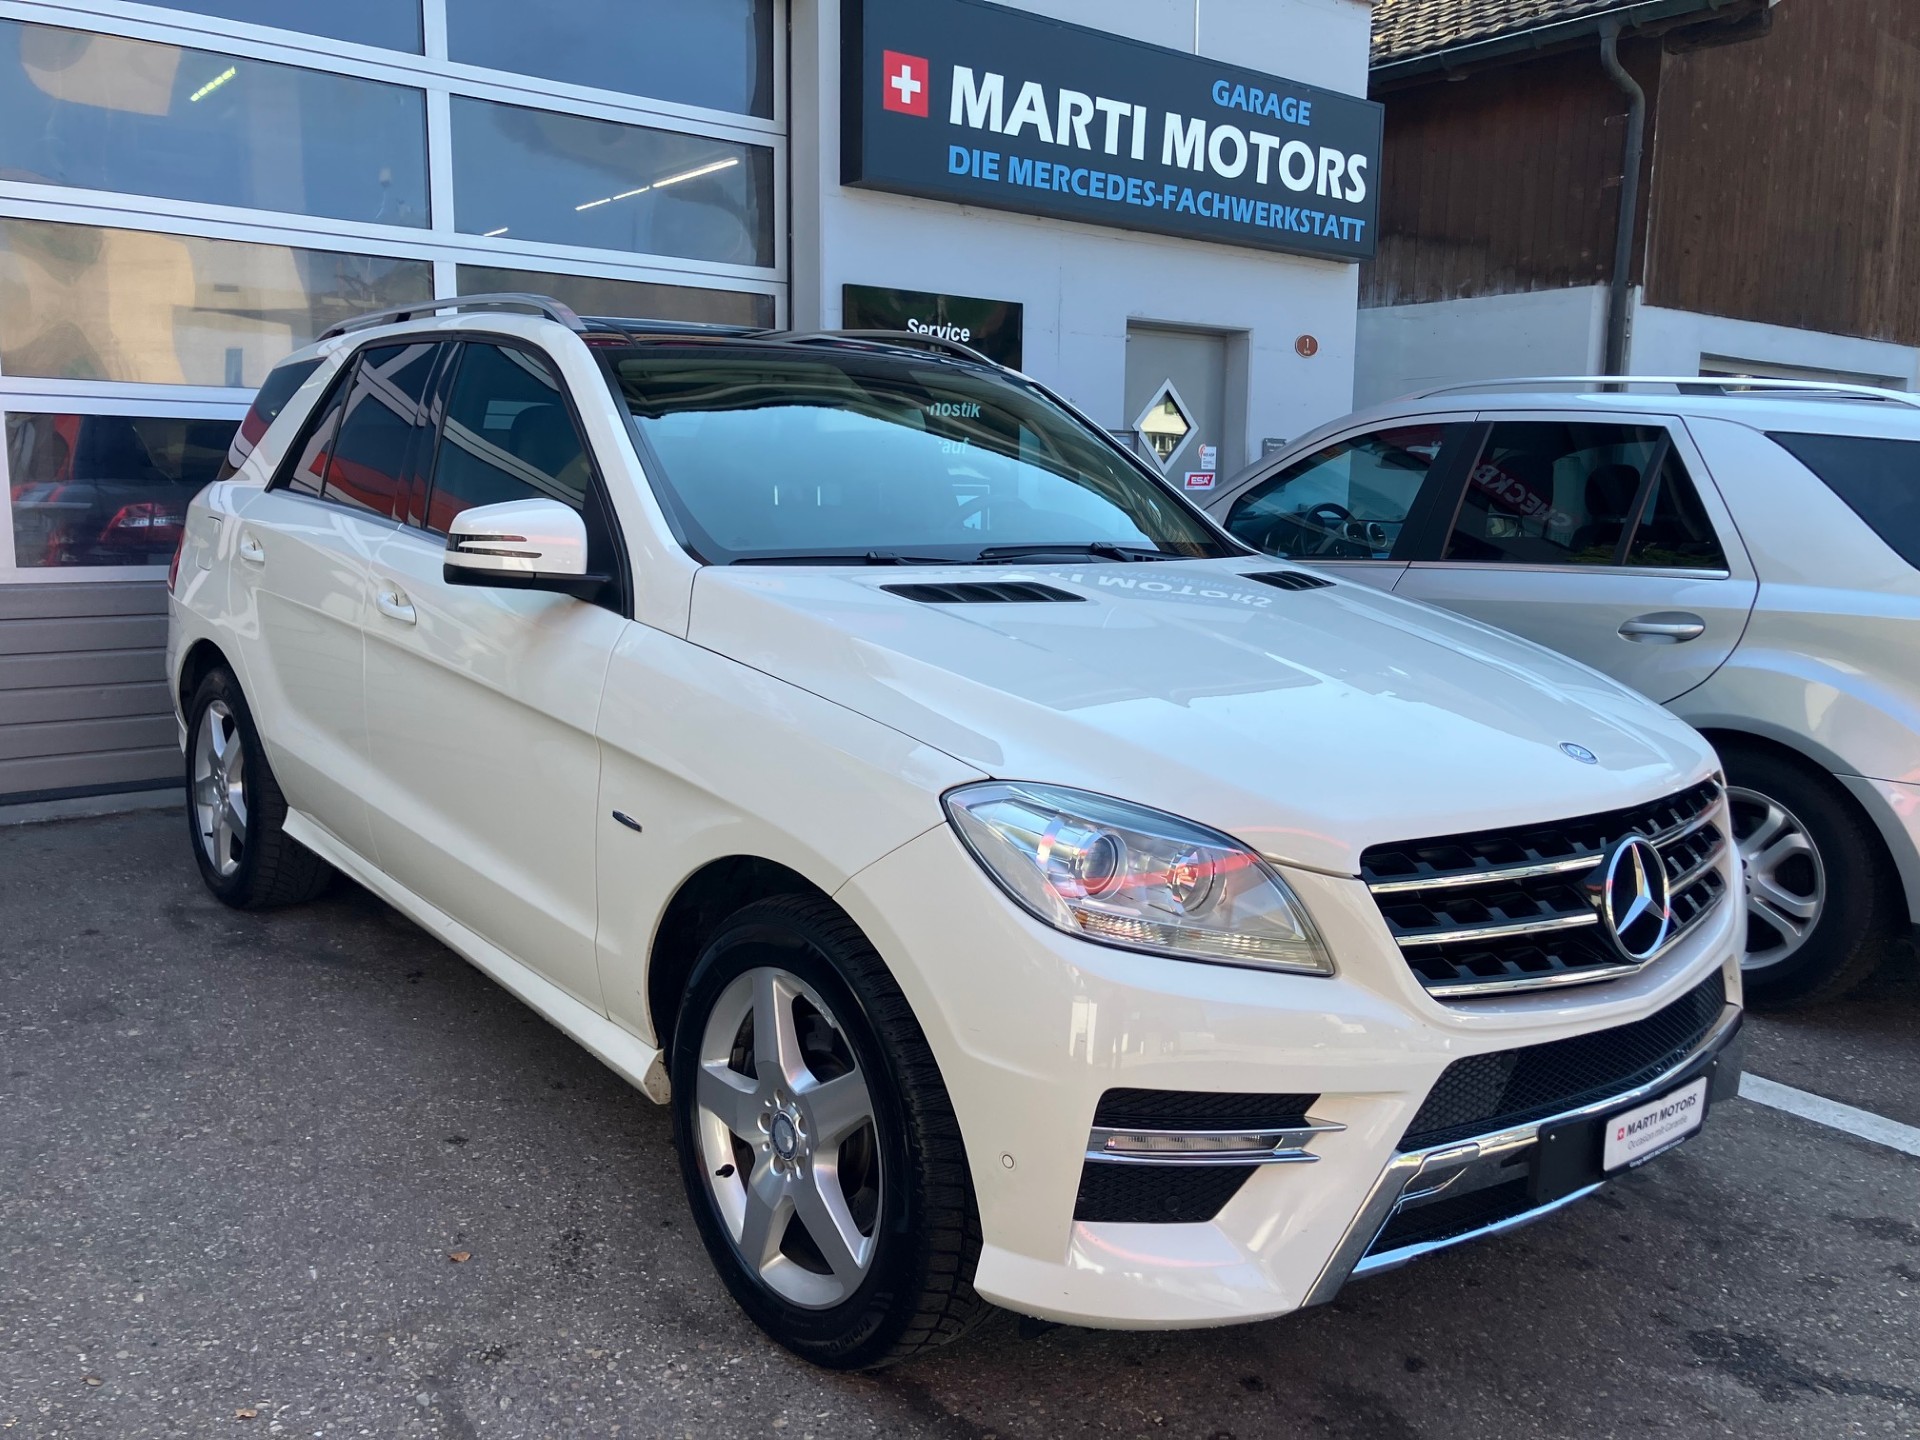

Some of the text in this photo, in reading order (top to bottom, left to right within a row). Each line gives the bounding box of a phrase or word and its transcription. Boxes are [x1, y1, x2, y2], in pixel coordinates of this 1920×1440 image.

[1211, 79, 1312, 127] GARAGE
[949, 65, 1368, 203] MARTI MOTORS
[948, 144, 1366, 243] DIE MERCEDES-FACHWERKSTATT
[906, 318, 971, 342] Service
[926, 402, 981, 418] nostik
[1626, 1093, 1697, 1136] MARTI MOTORS
[1628, 1131, 1654, 1151] Occasion
